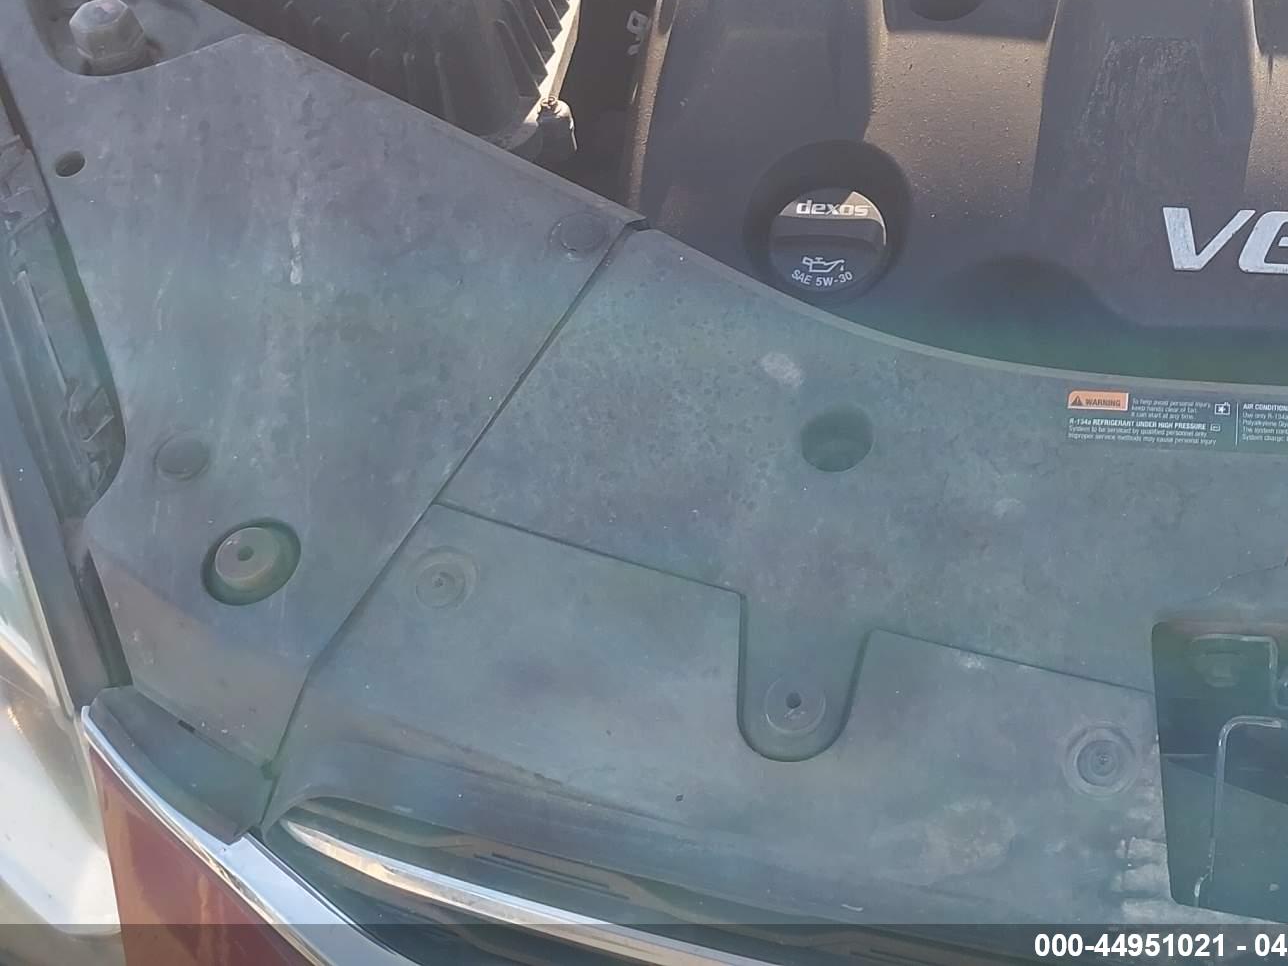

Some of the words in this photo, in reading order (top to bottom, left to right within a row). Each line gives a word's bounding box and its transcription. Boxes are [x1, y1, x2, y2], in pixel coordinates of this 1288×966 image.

[796, 199, 871, 217] dexos
[791, 269, 812, 285] SAE
[815, 271, 853, 287] 5W-30
[1085, 398, 1121, 407] WARNING
[1092, 418, 1135, 427] REFRIGERANT
[1136, 420, 1157, 428] UNDER
[1158, 421, 1174, 429] HIGH
[1174, 422, 1206, 430] PRESSURE
